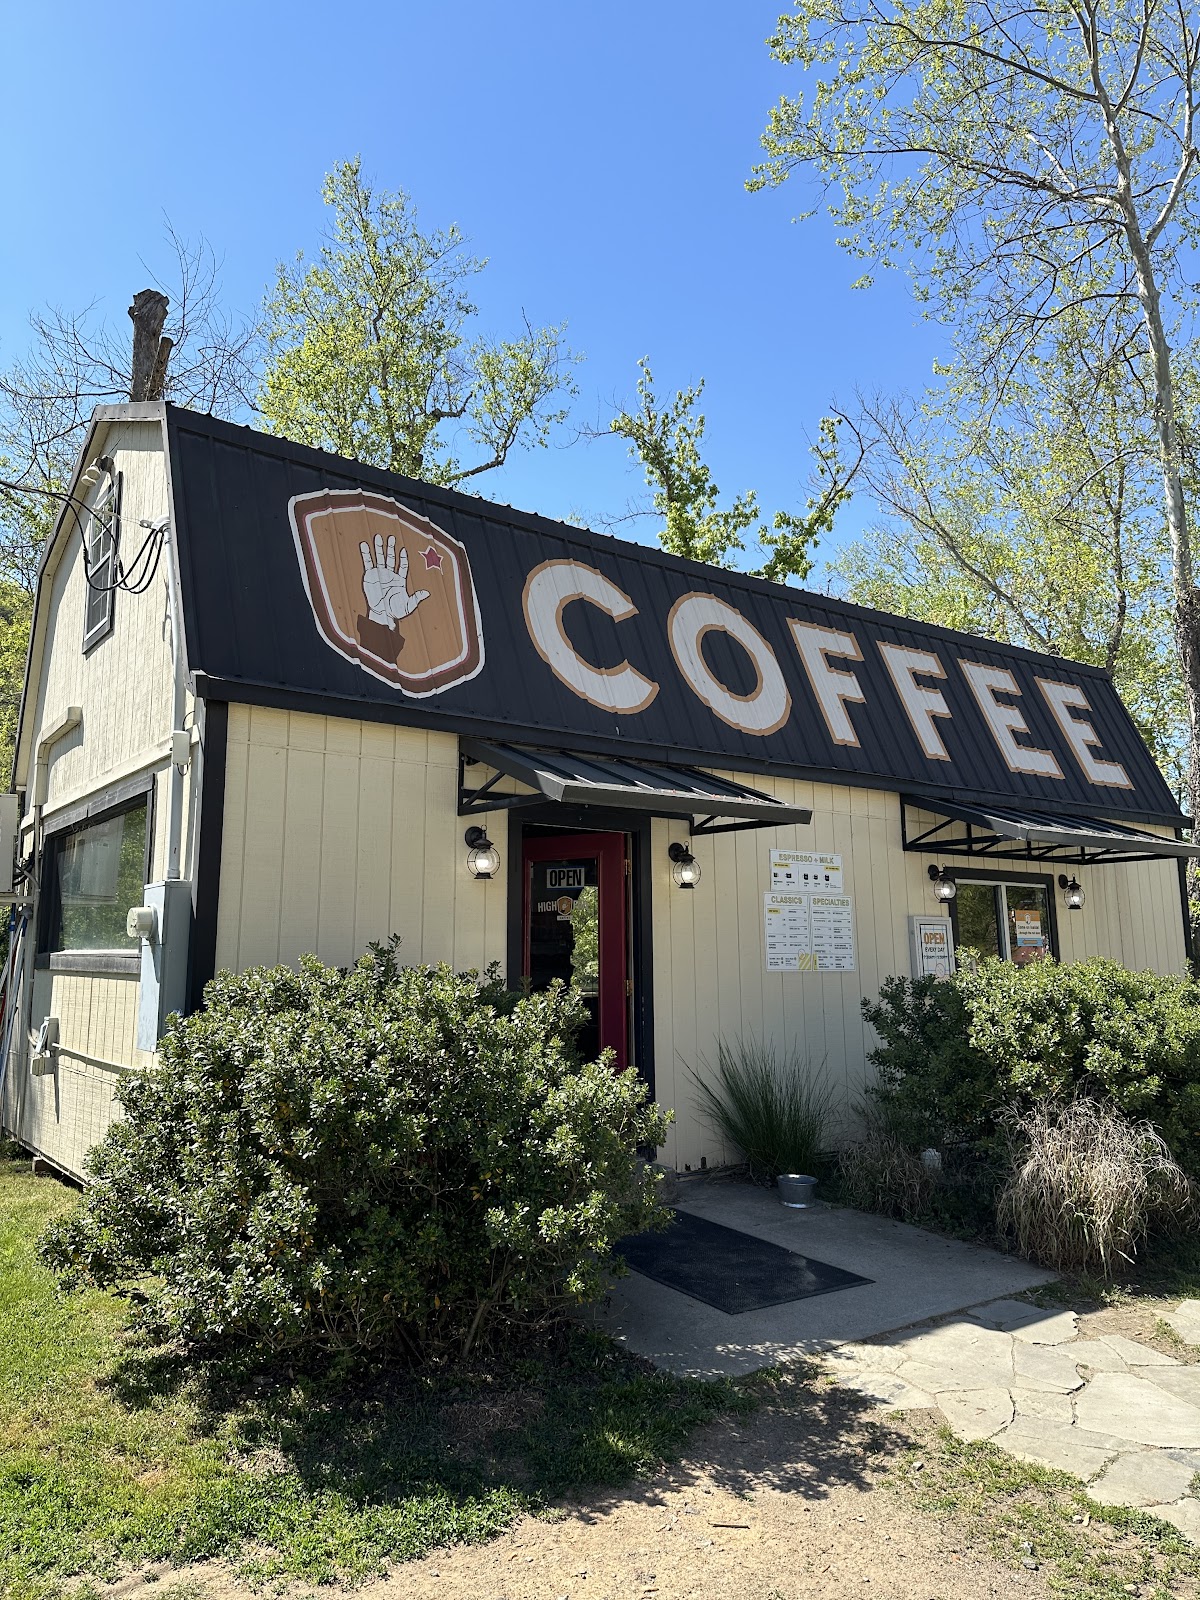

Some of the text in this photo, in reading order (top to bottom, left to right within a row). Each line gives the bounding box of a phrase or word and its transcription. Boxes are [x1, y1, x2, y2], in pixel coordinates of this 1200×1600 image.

[522, 559, 1134, 791] COFFEE
[779, 853, 813, 863] ESPRESSO
[549, 869, 582, 887] OPEN
[771, 895, 803, 904] CLASSICS
[812, 897, 850, 906] SPECIALTIES
[537, 900, 557, 912] HIGH
[923, 932, 945, 945] OPEN
